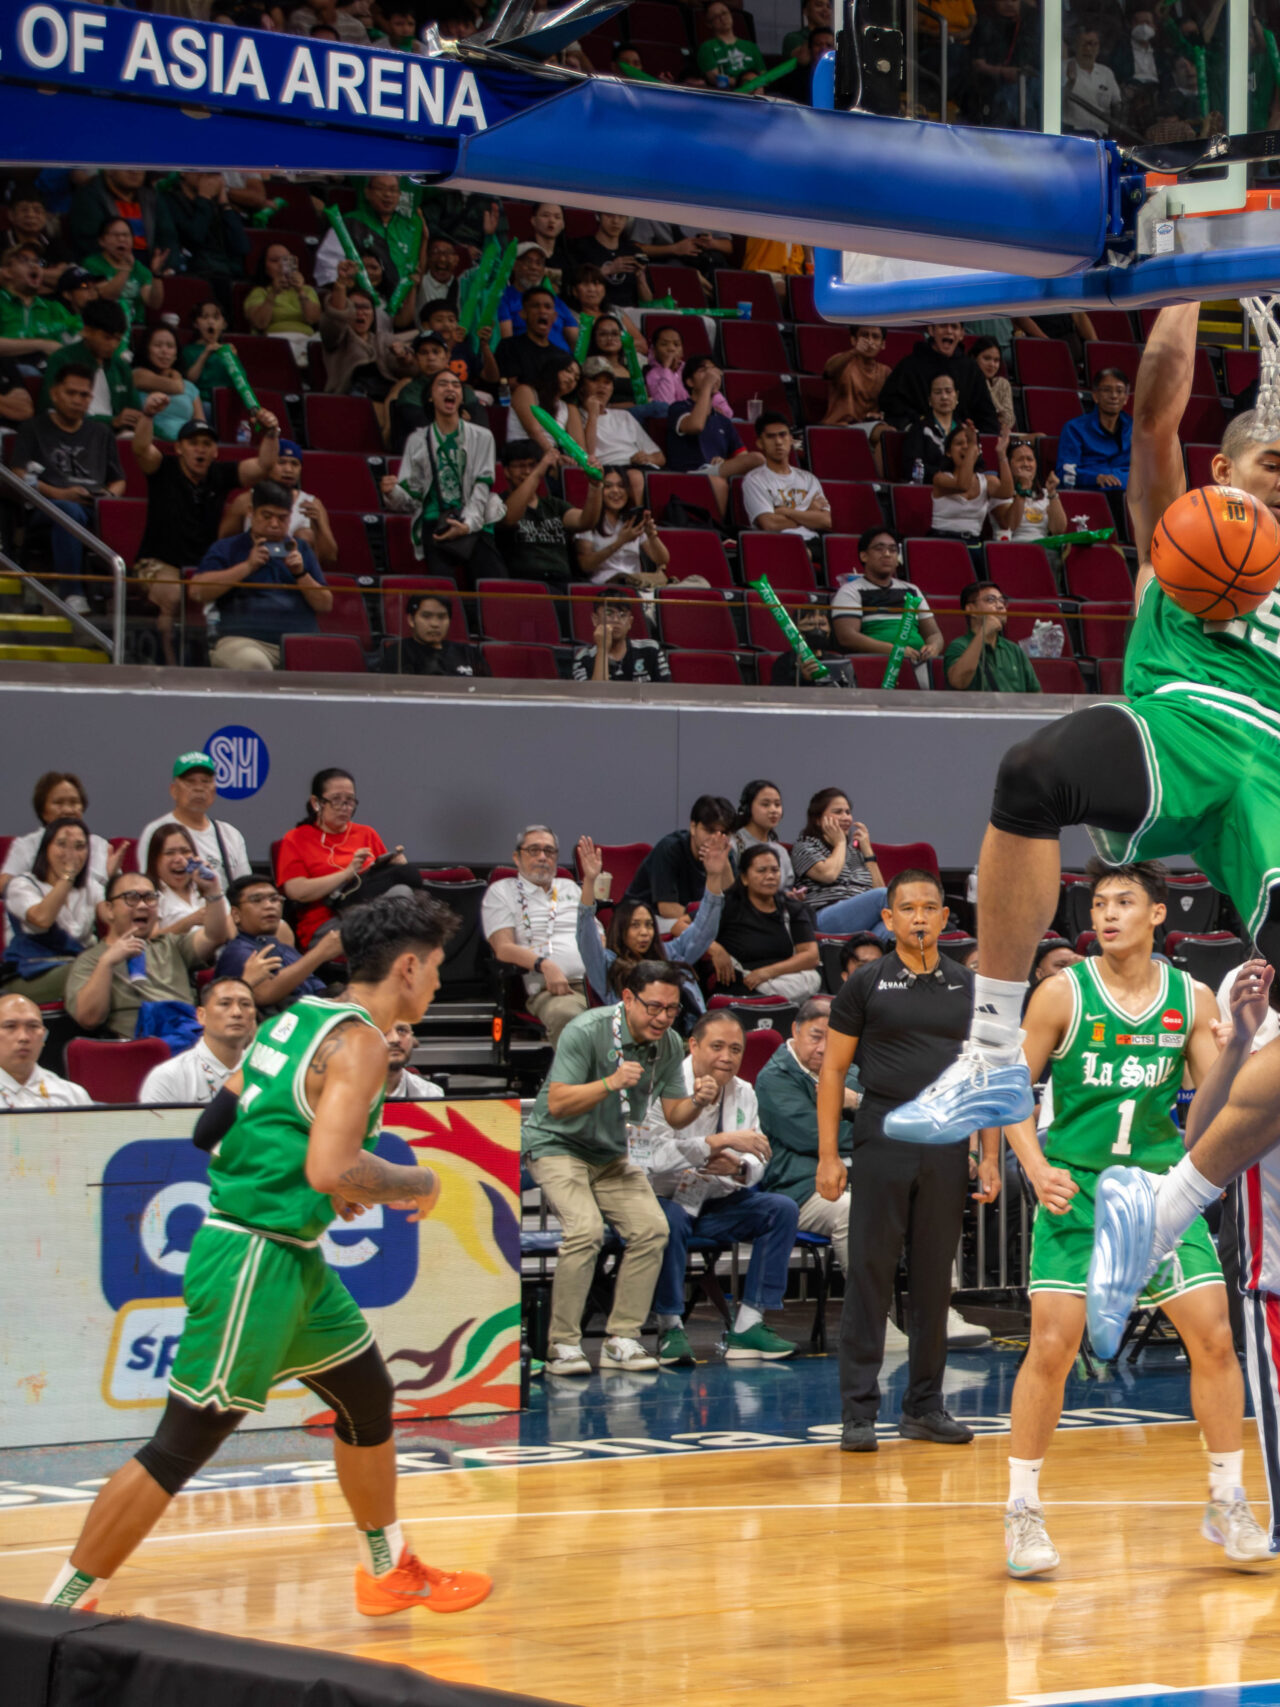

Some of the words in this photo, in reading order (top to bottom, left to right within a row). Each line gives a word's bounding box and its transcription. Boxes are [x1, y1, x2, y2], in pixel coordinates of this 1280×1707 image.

[18, 4, 107, 74] OF
[121, 20, 271, 101] ASIA
[281, 46, 489, 132] ARENA
[210, 735, 259, 789] SM
[1132, 1035, 1154, 1044] ICTSI
[1081, 1052, 1114, 1087] La
[1111, 1099, 1137, 1156] 1
